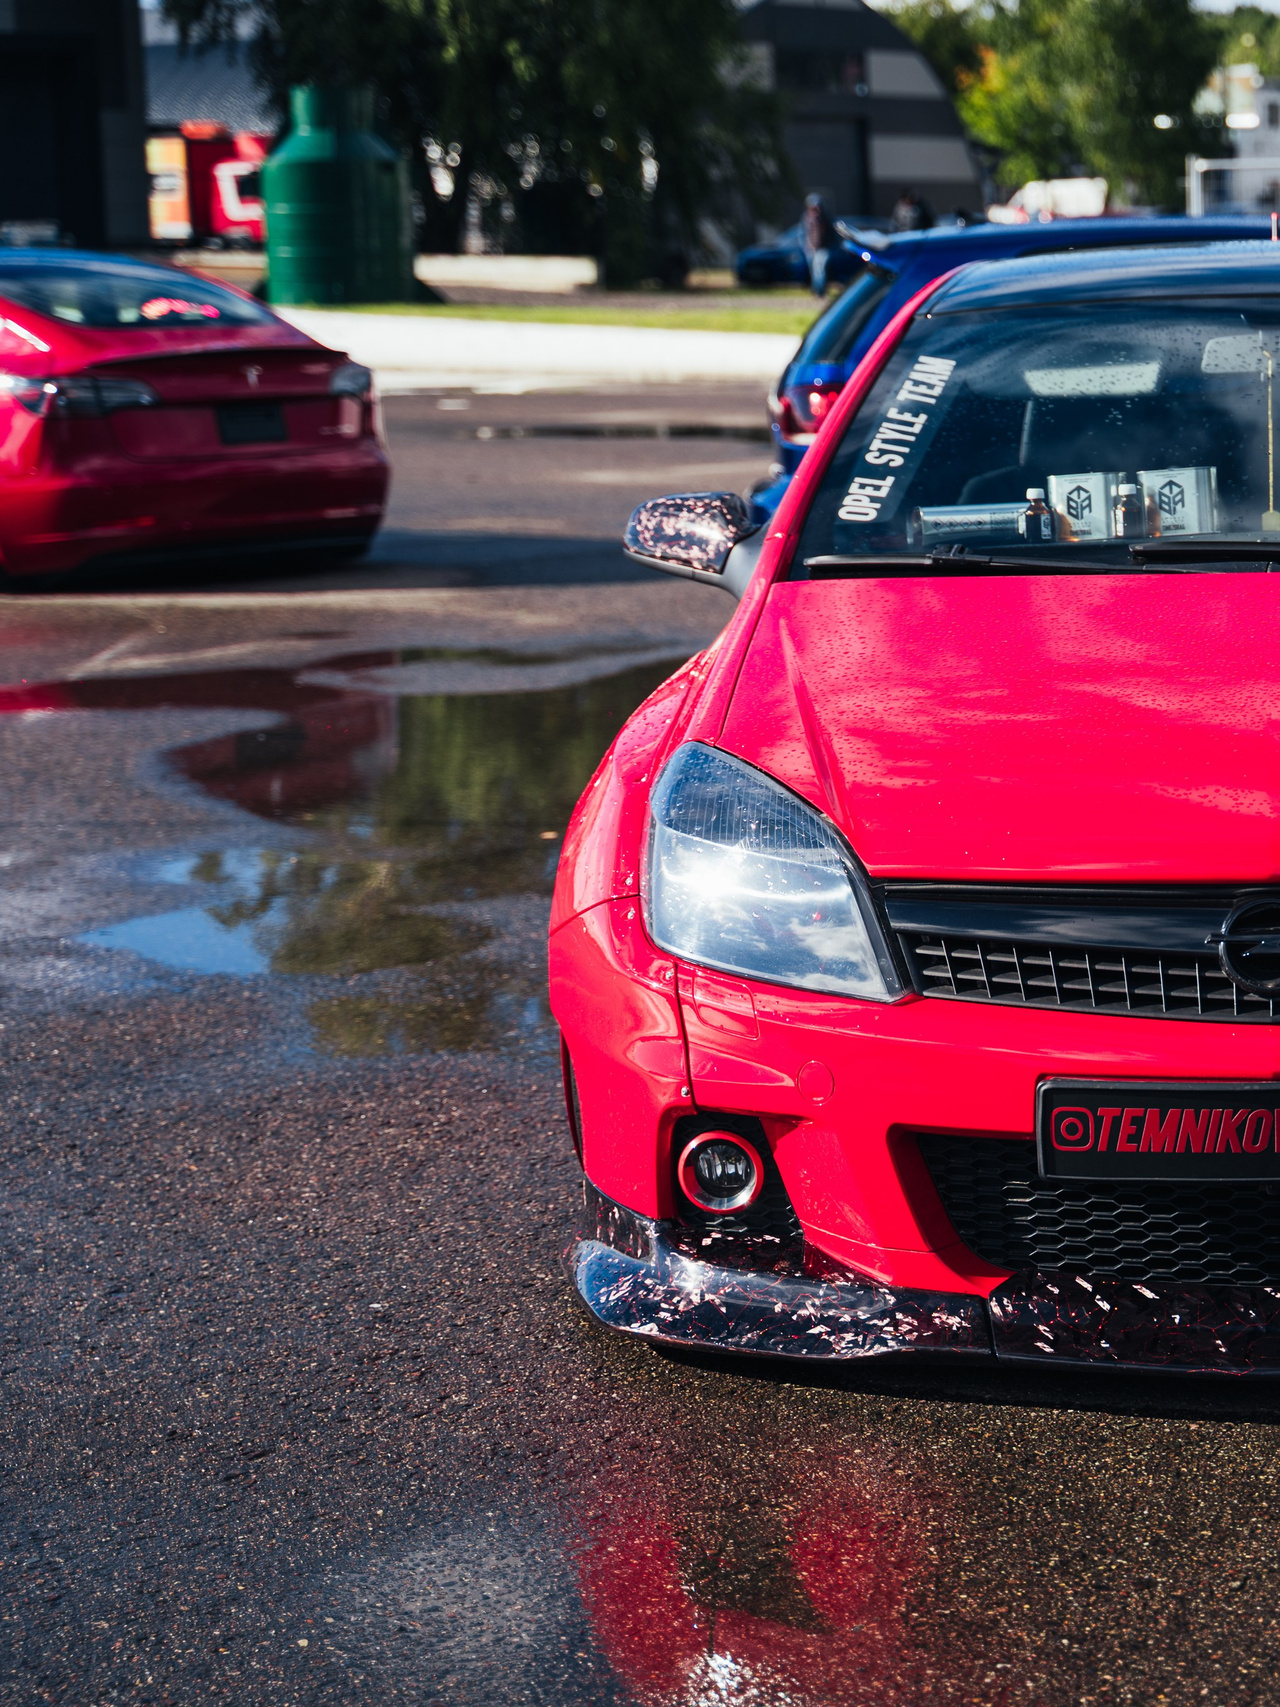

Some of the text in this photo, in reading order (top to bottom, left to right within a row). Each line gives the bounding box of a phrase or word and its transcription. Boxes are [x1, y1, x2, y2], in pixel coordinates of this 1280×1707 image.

[838, 355, 957, 522] OPEL STYLE TEAM
